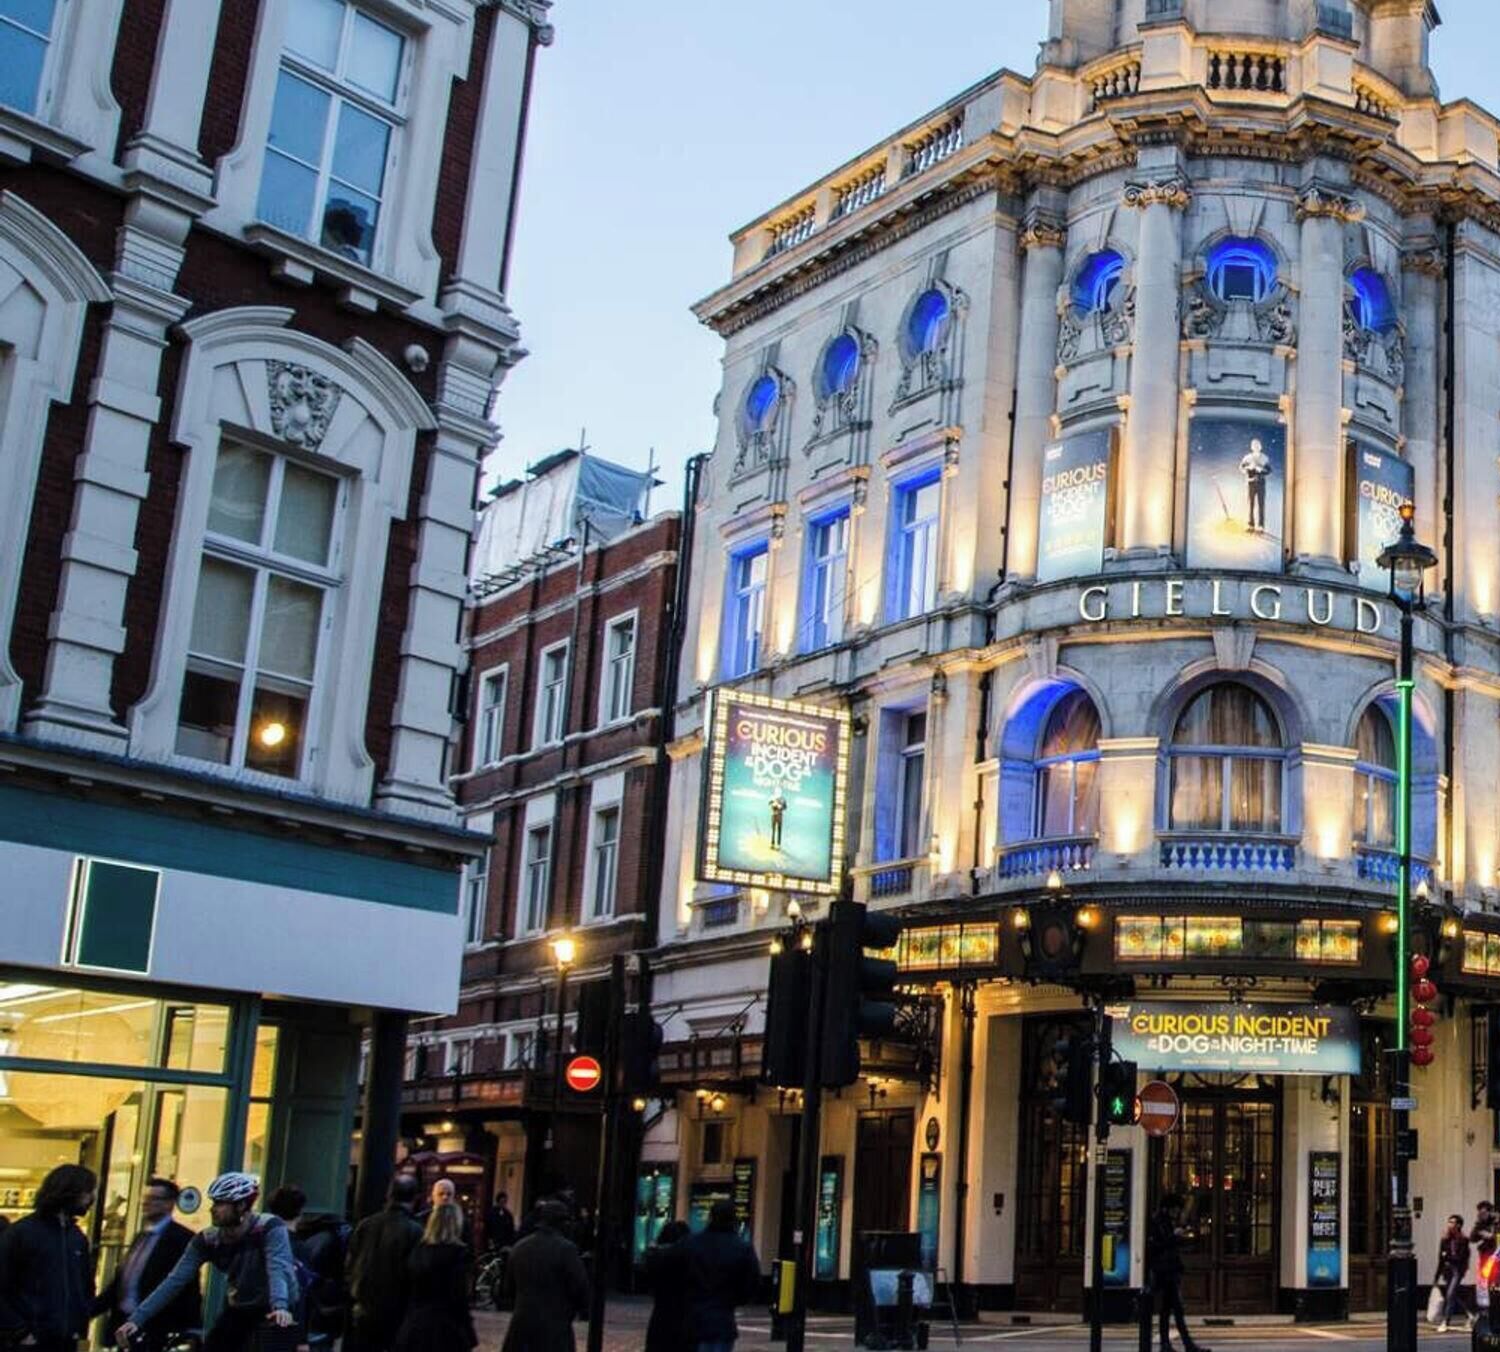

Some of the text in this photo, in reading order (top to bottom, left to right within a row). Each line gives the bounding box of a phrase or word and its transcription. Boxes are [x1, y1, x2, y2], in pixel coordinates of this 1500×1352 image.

[1043, 462, 1106, 494] CURIOUS
[1079, 580, 1382, 633] GIELGUD
[736, 720, 827, 752] CURIOUS
[751, 742, 818, 767] INCIDENT
[753, 756, 802, 781] DOG
[1132, 1013, 1331, 1038] CURIOUS INCIDENT
[1158, 1034, 1209, 1053] DOG
[1221, 1035, 1318, 1055] NIGHT-TIME
